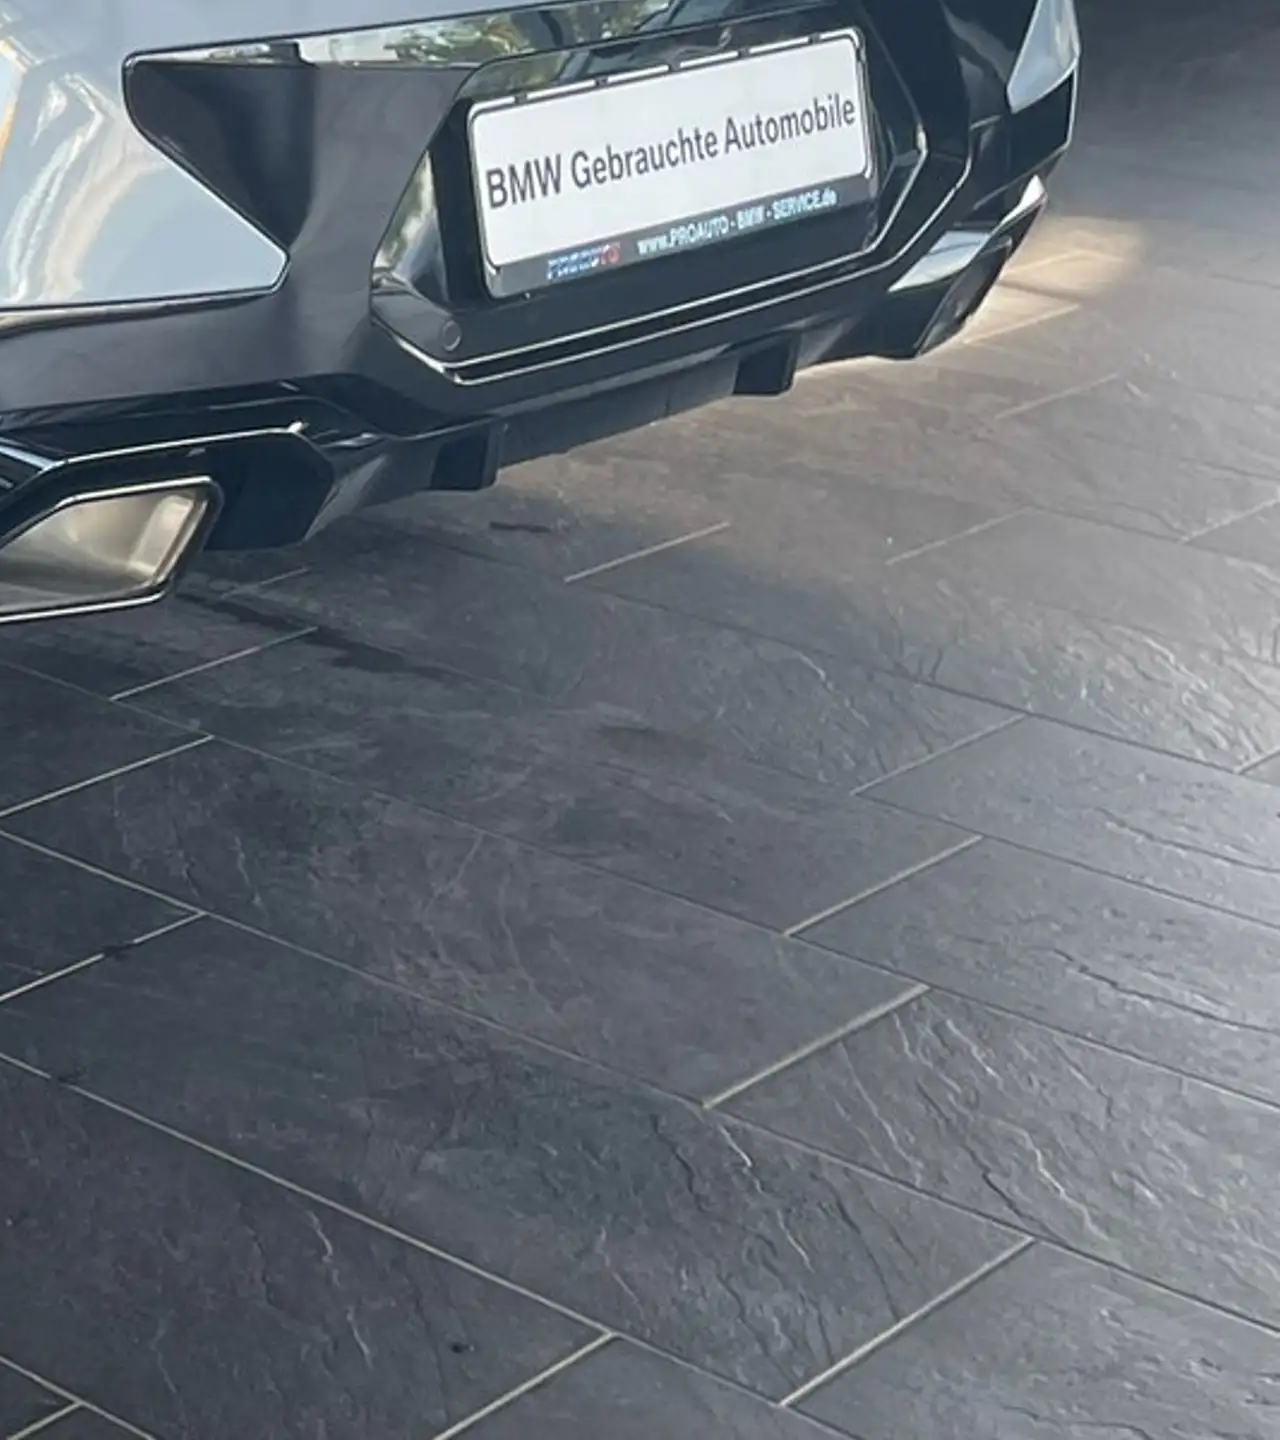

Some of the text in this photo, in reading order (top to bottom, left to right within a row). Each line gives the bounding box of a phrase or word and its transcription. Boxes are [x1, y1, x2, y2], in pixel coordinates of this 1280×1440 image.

[486, 93, 856, 210] BMW Gebrauchte Automobile
